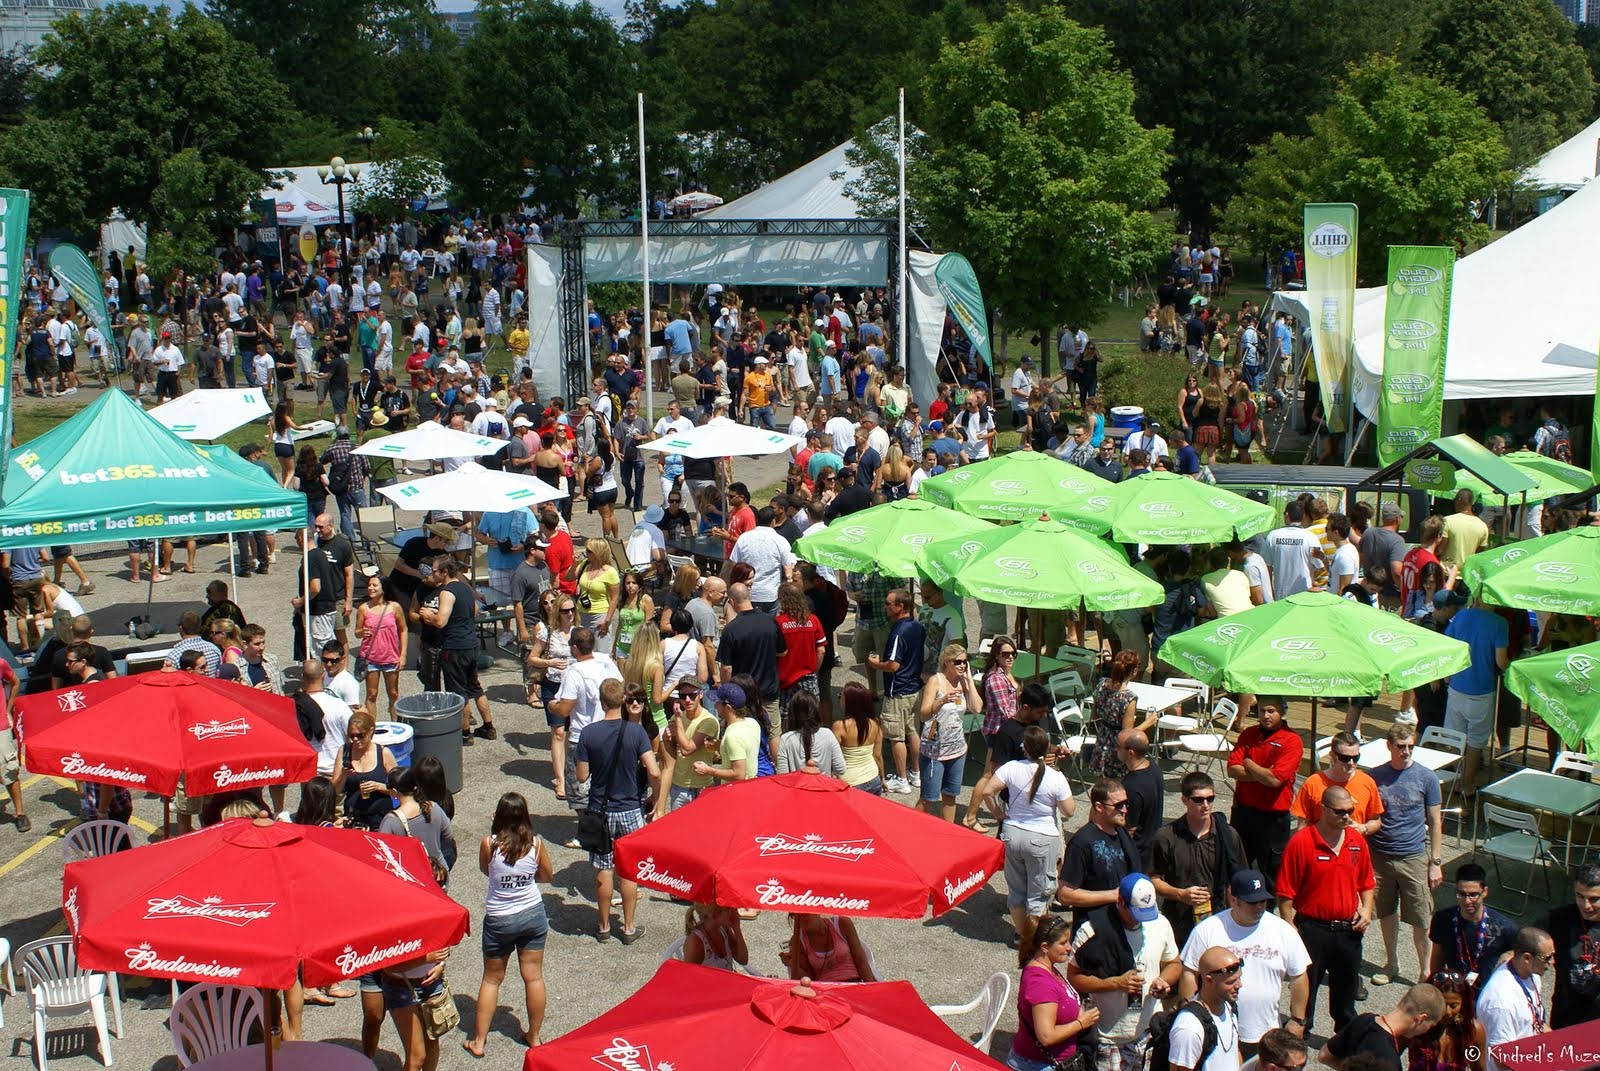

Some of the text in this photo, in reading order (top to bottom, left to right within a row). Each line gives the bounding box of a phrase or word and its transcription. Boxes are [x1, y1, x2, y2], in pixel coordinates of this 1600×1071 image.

[59, 464, 210, 485] bet365.net
[105, 512, 196, 530] bet365.net
[205, 505, 293, 522] bet365.net
[2, 518, 97, 536] bet365.net
[1276, 537, 1304, 546] HASSELHOFF
[1003, 560, 1034, 570] BL
[1282, 640, 1320, 650] BL
[1259, 675, 1288, 683] BUD
[1569, 658, 1595, 680] BL
[188, 722, 251, 736] Budweiser
[61, 756, 147, 784] Budweiser
[213, 766, 285, 788] Budweiser
[755, 835, 875, 856] Budweiser
[636, 861, 694, 894] Budweiser
[944, 868, 986, 904] Budweiser
[755, 883, 870, 911] Budweiser
[147, 898, 271, 919] Budweiser
[124, 948, 243, 978] Budweiser
[335, 938, 422, 976] Budweiser
